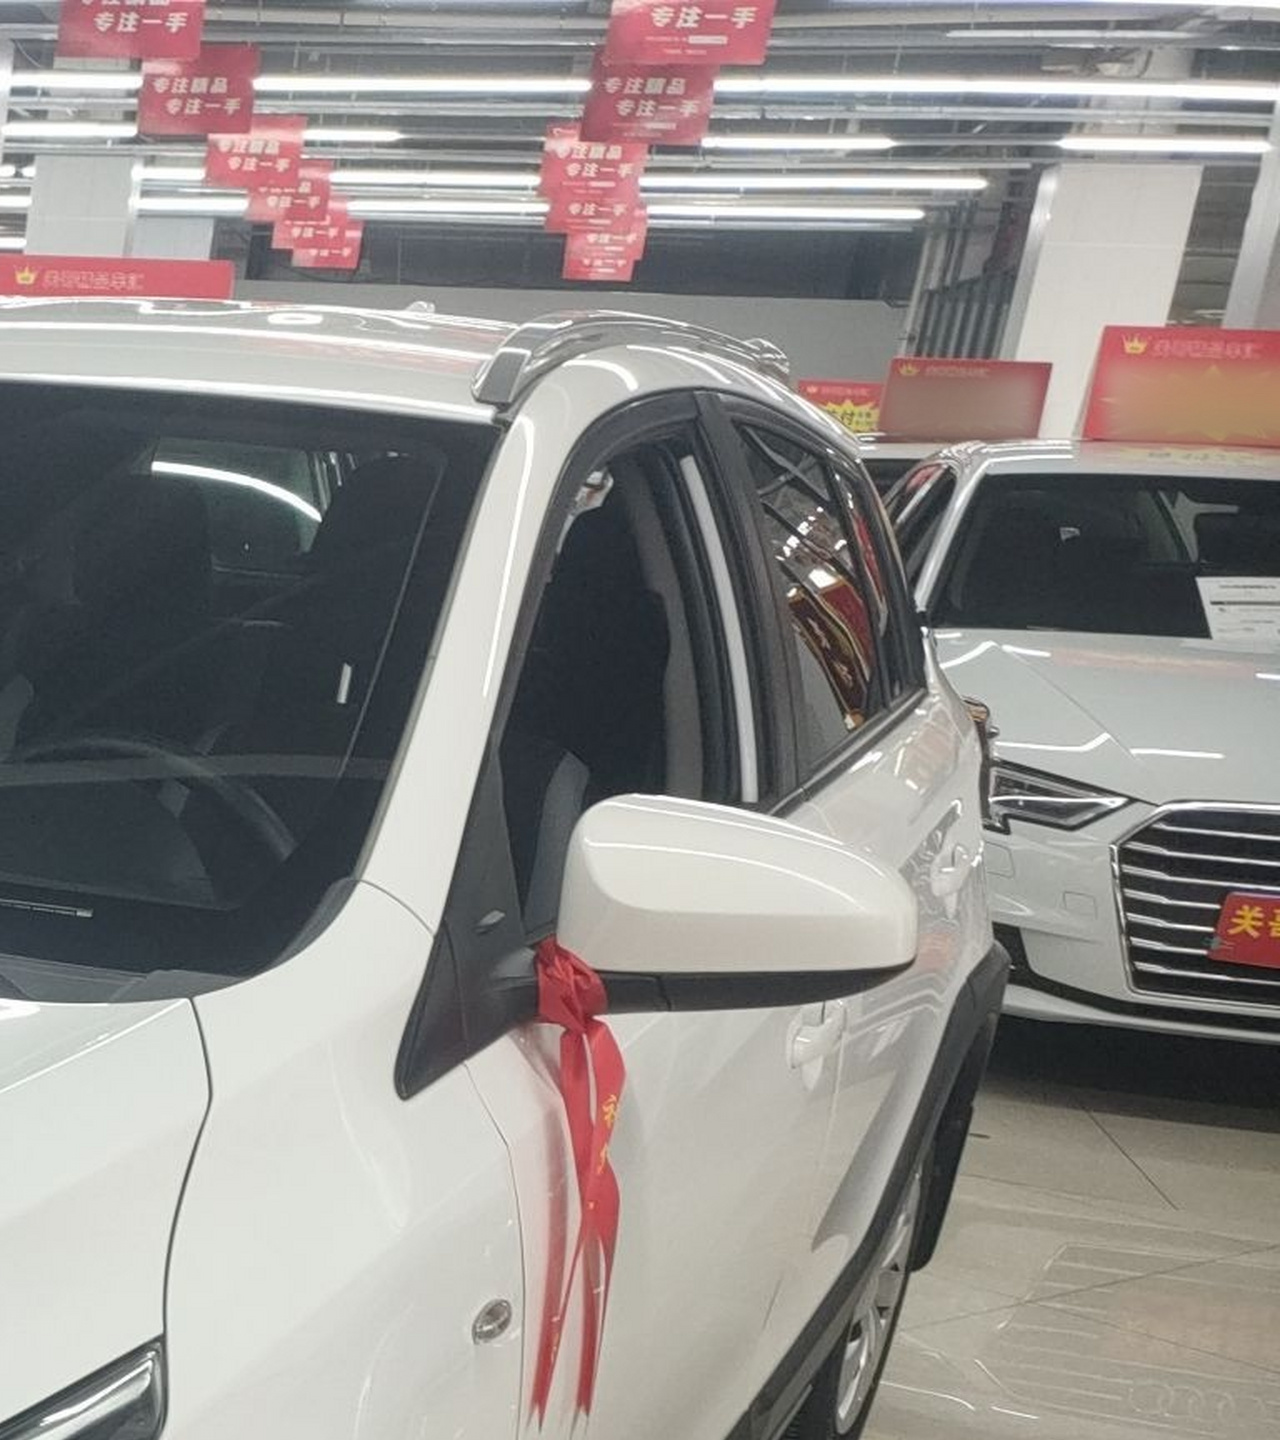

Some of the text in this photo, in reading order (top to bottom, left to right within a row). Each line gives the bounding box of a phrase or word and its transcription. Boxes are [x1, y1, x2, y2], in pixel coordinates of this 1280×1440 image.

[94, 12, 188, 34] 专注一手
[650, 6, 758, 29] 专注一手
[166, 98, 241, 115] 专注一手
[616, 100, 700, 118] 专注一手
[228, 157, 290, 173] 专注一手
[566, 163, 634, 178] 专注一手
